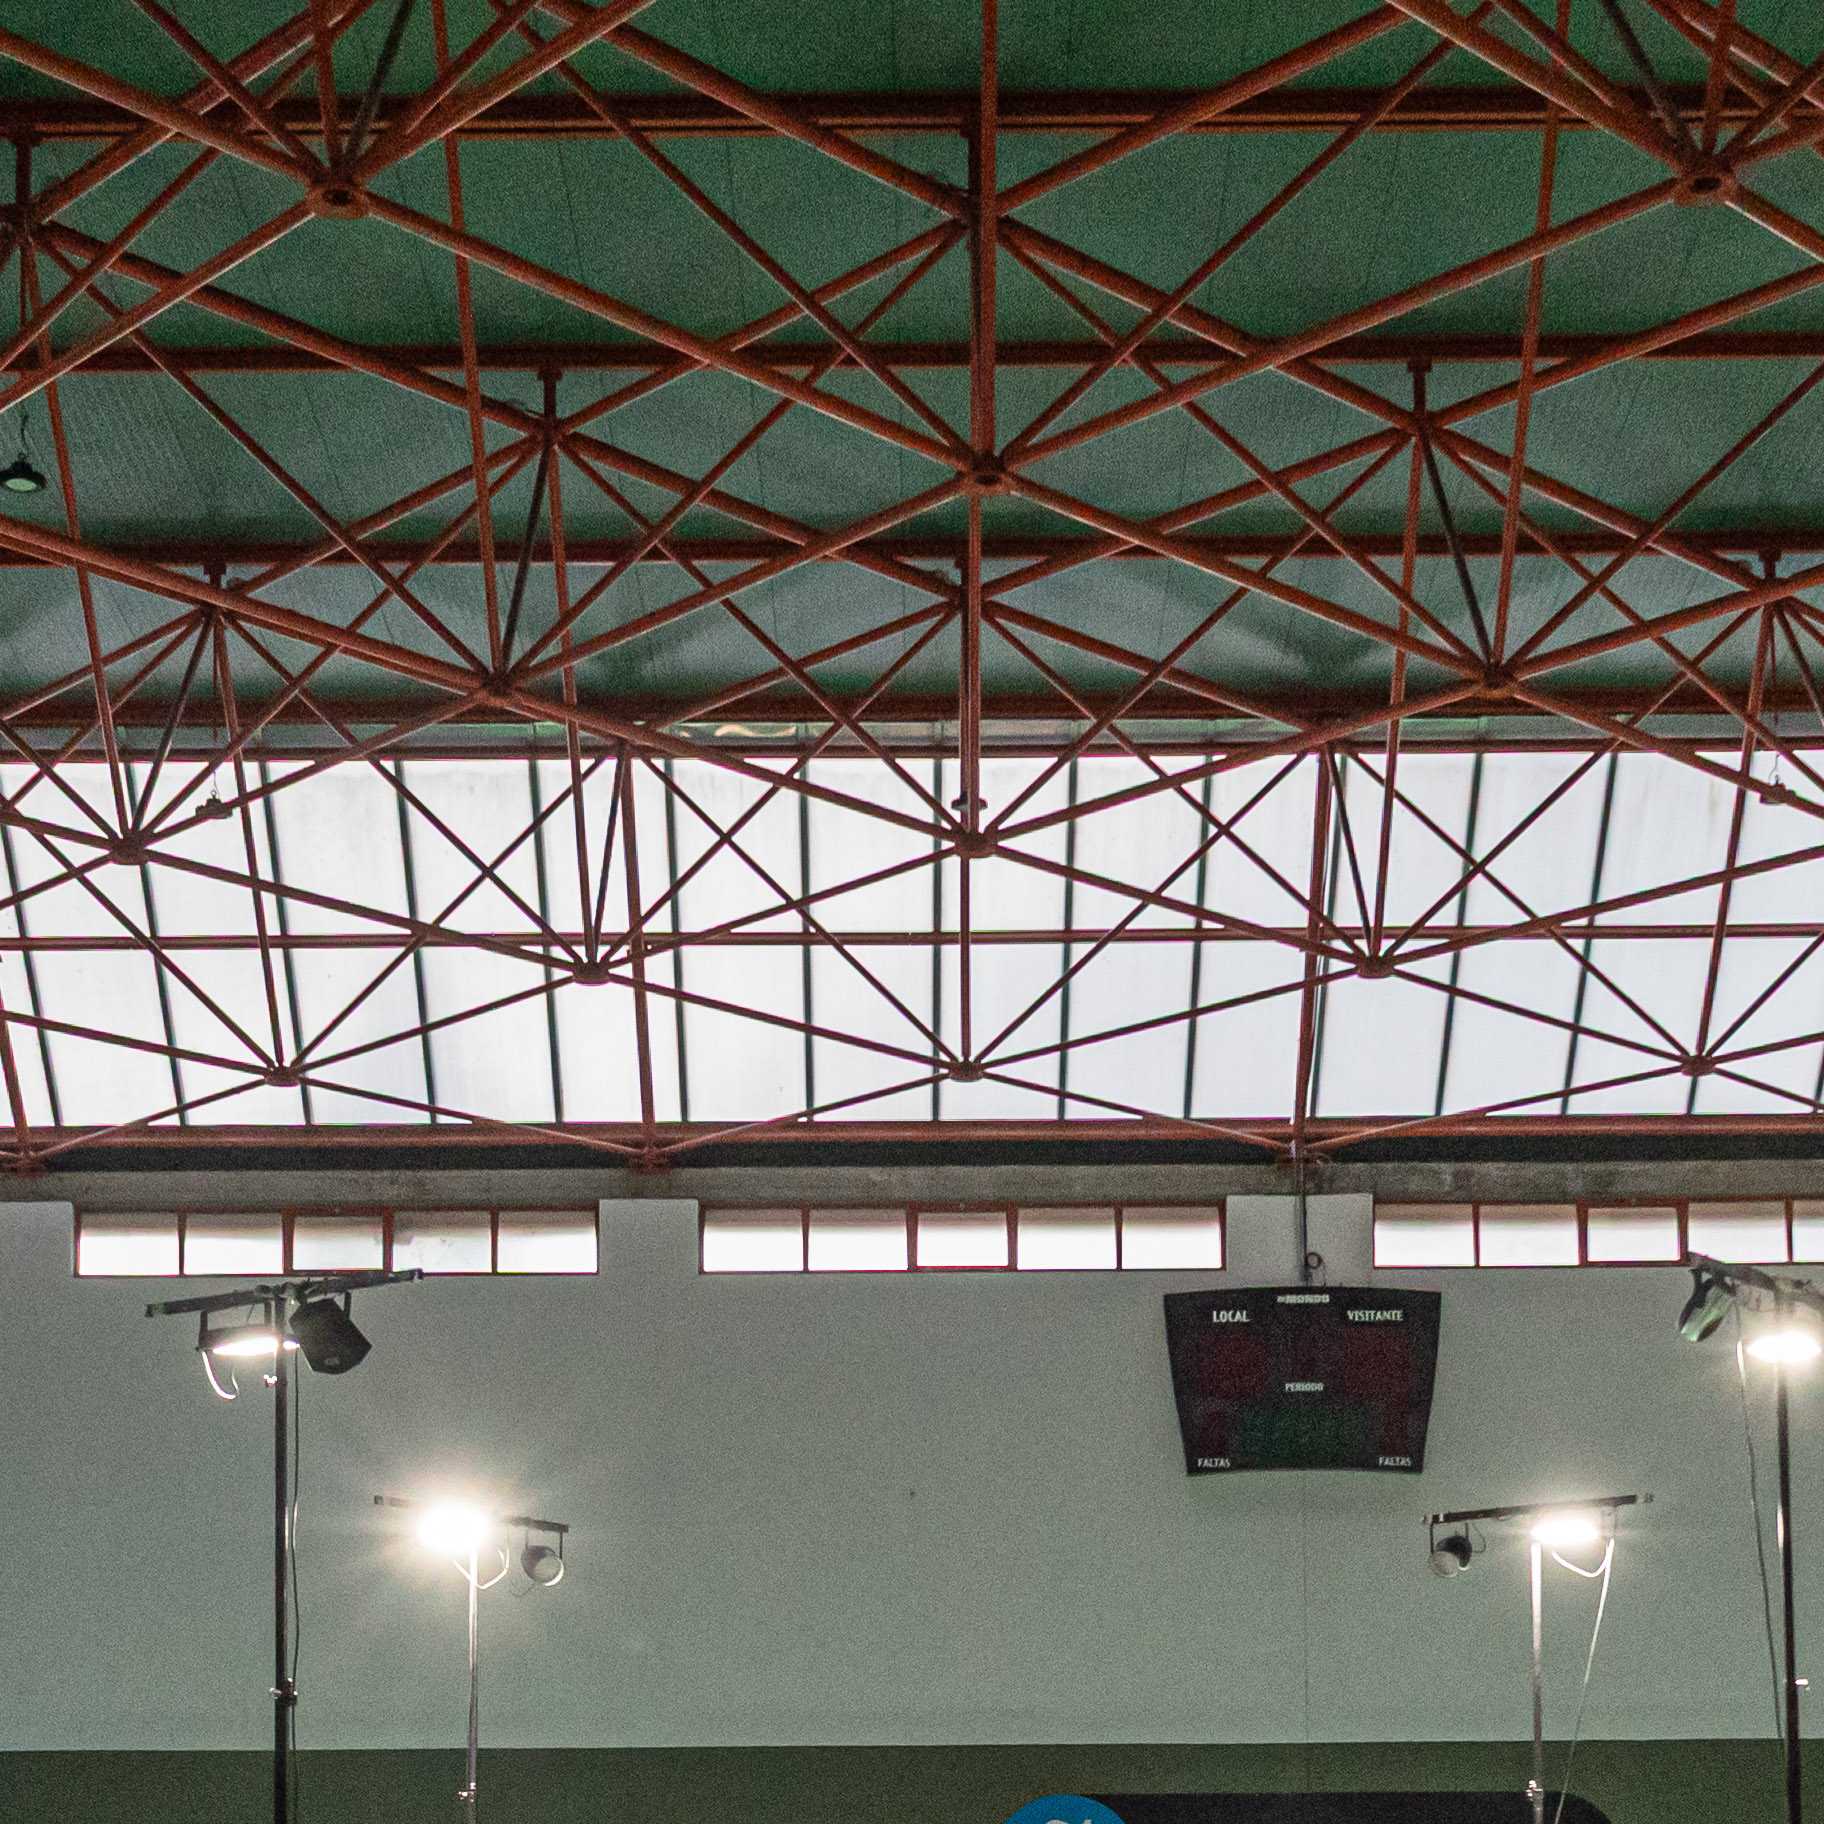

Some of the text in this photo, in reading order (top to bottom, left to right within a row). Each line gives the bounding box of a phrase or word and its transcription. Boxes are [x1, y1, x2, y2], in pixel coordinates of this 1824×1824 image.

[1212, 1310, 1250, 1323] LOCAL
[1347, 1310, 1404, 1322] VISITANTE
[1285, 1383, 1324, 1392] PERIODO
[1197, 1457, 1230, 1468] FALTAS
[1379, 1456, 1412, 1467] FALTAS
